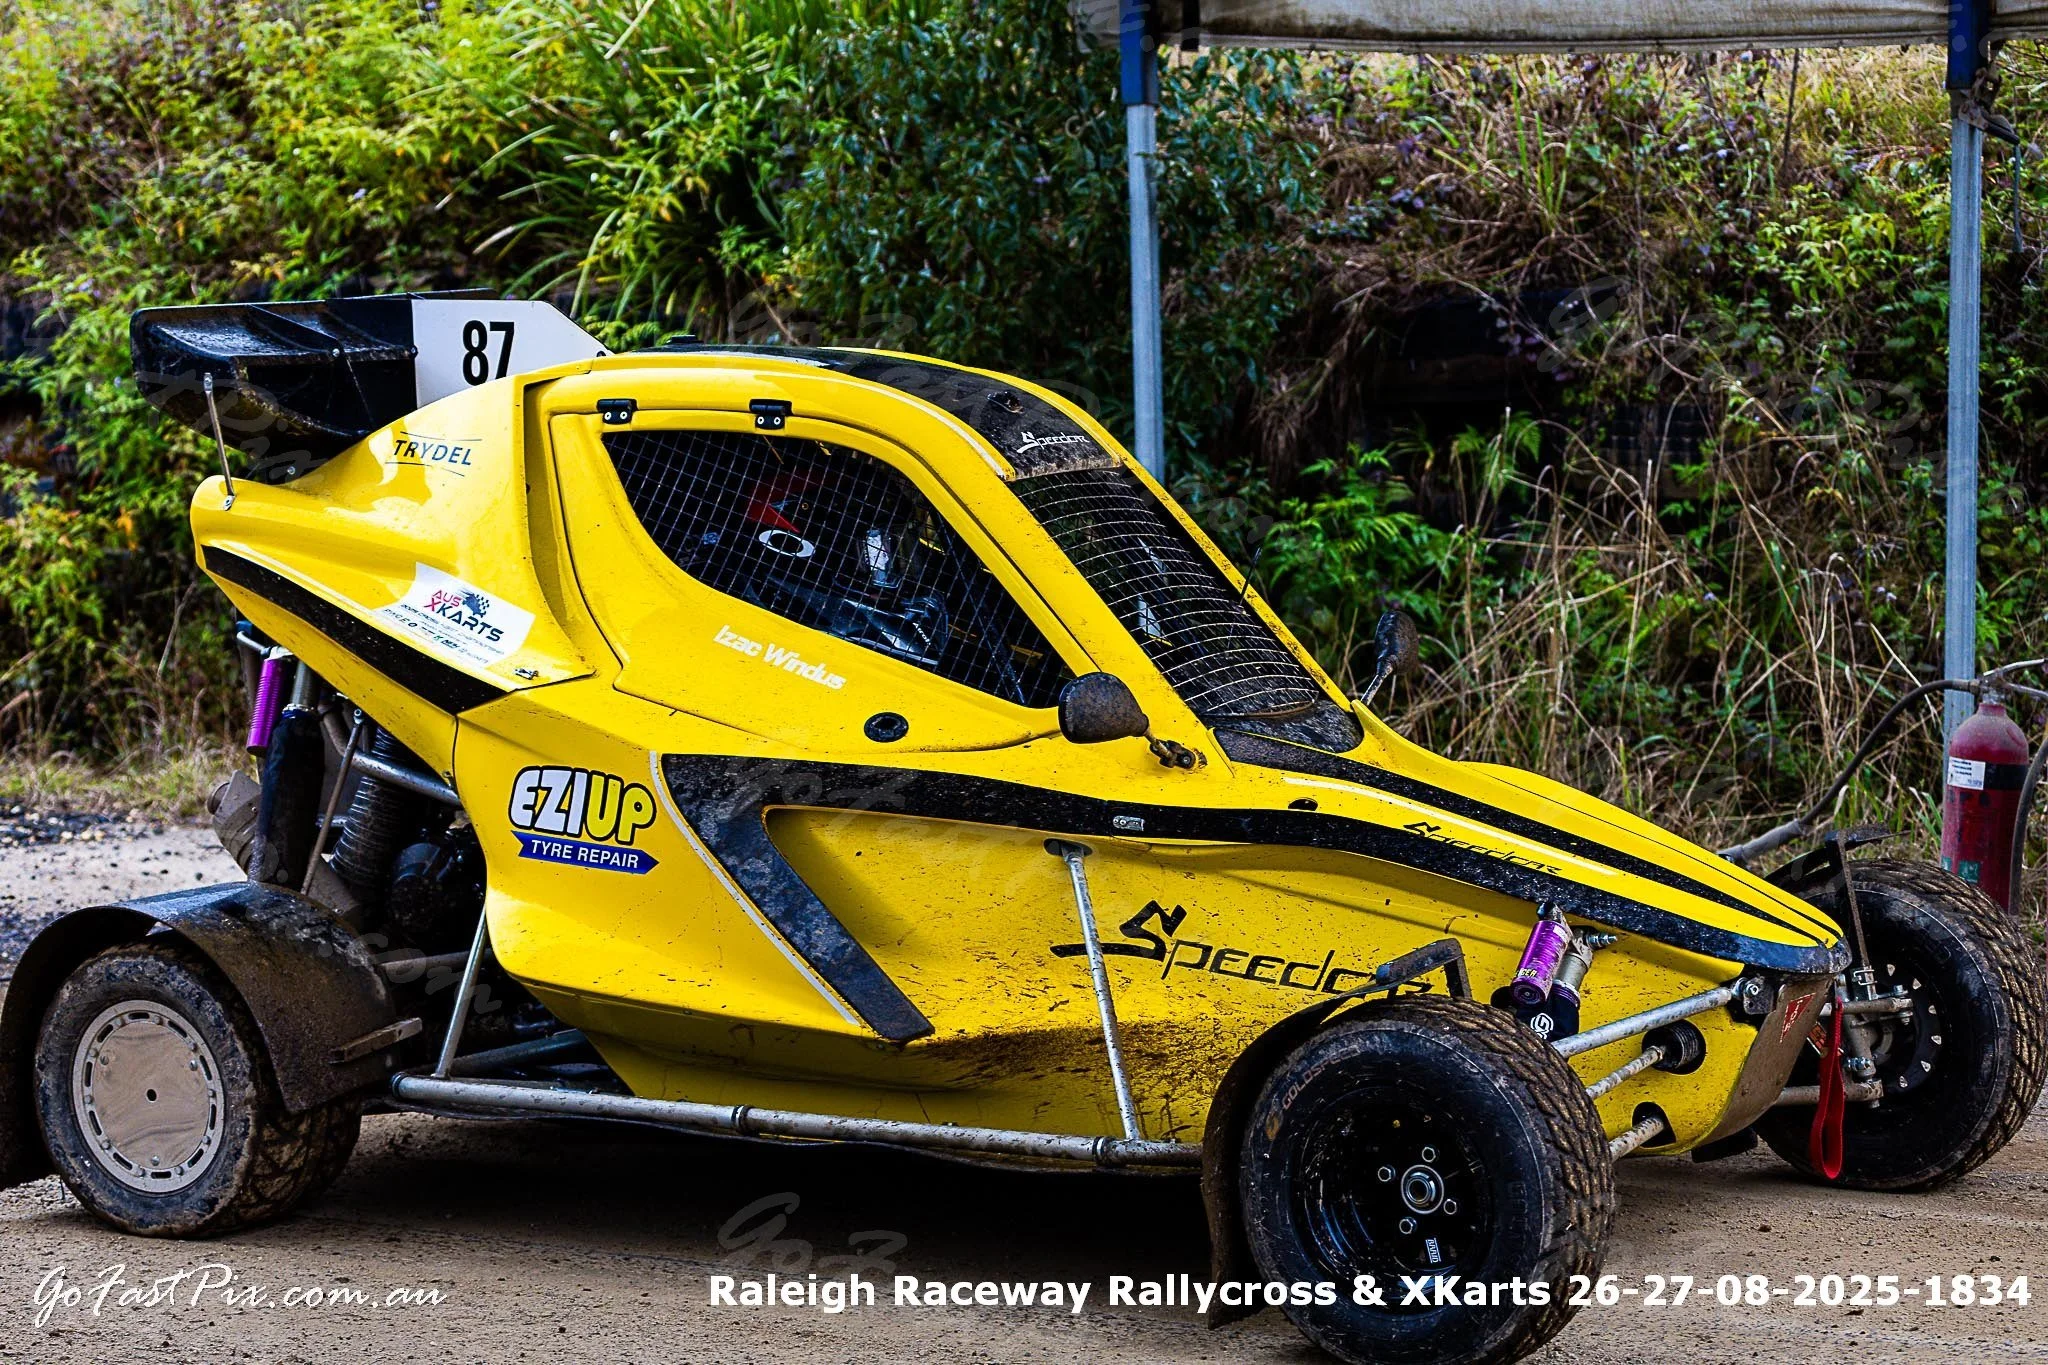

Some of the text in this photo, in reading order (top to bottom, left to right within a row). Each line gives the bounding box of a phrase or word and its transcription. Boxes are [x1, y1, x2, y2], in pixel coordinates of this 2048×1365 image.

[462, 320, 514, 386] 87
[393, 439, 472, 466] TRYDEL
[432, 589, 462, 607] AUS
[424, 597, 504, 642] XKARTS
[713, 624, 847, 690] Izac Windus
[531, 839, 640, 869] TYRE REPAIR
